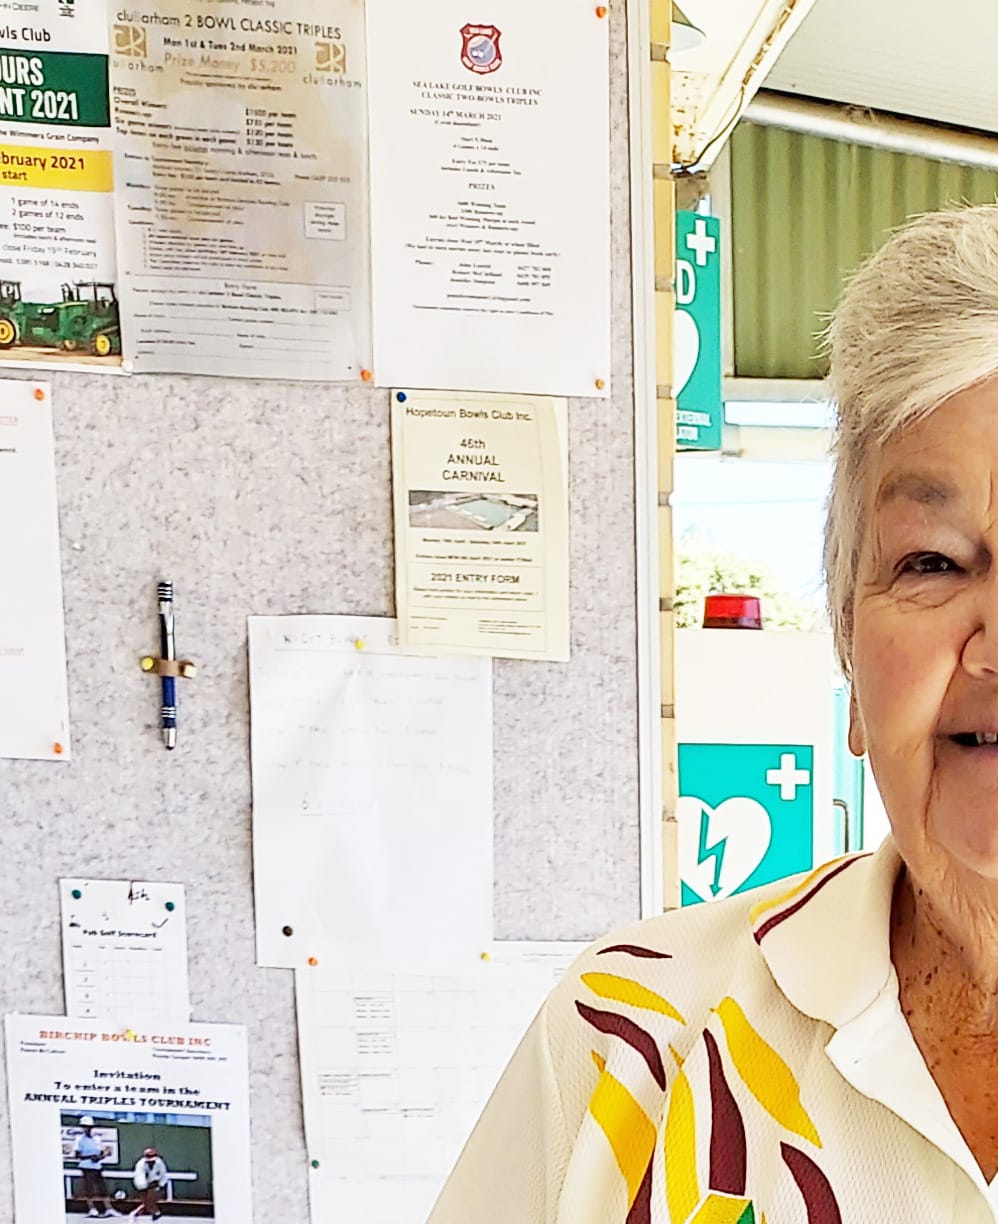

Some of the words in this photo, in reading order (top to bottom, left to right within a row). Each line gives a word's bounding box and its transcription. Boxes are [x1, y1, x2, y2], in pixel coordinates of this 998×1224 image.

[184, 14, 193, 27] 2
[196, 15, 237, 31] BOWL
[240, 18, 293, 35] CLASSIC
[296, 23, 342, 39] TRIPLES
[21, 27, 51, 42] Club
[229, 41, 246, 52] 2nd
[0, 55, 44, 87] URS
[31, 89, 79, 120] 2021
[1, 151, 47, 171] bruary
[50, 155, 85, 170] 2021
[2, 170, 28, 181] start
[677, 260, 697, 305] D
[405, 408, 457, 418] Hopetoun
[459, 408, 489, 419] Bowls
[492, 409, 514, 420] Club
[447, 454, 500, 466] ANNUAL
[442, 470, 505, 482] CARNIVAL
[39, 1030, 98, 1040] BIRCHIP
[101, 1032, 148, 1043] BOLS
[151, 1034, 186, 1046] CLUB
[93, 1068, 161, 1080] Invitation
[54, 1081, 72, 1091] To
[74, 1083, 110, 1093] enter
[179, 1086, 201, 1096] the
[24, 1092, 78, 1104] ANNUAL
[80, 1095, 136, 1106] TRIPLES
[139, 1098, 231, 1111] TOURNAMENT
